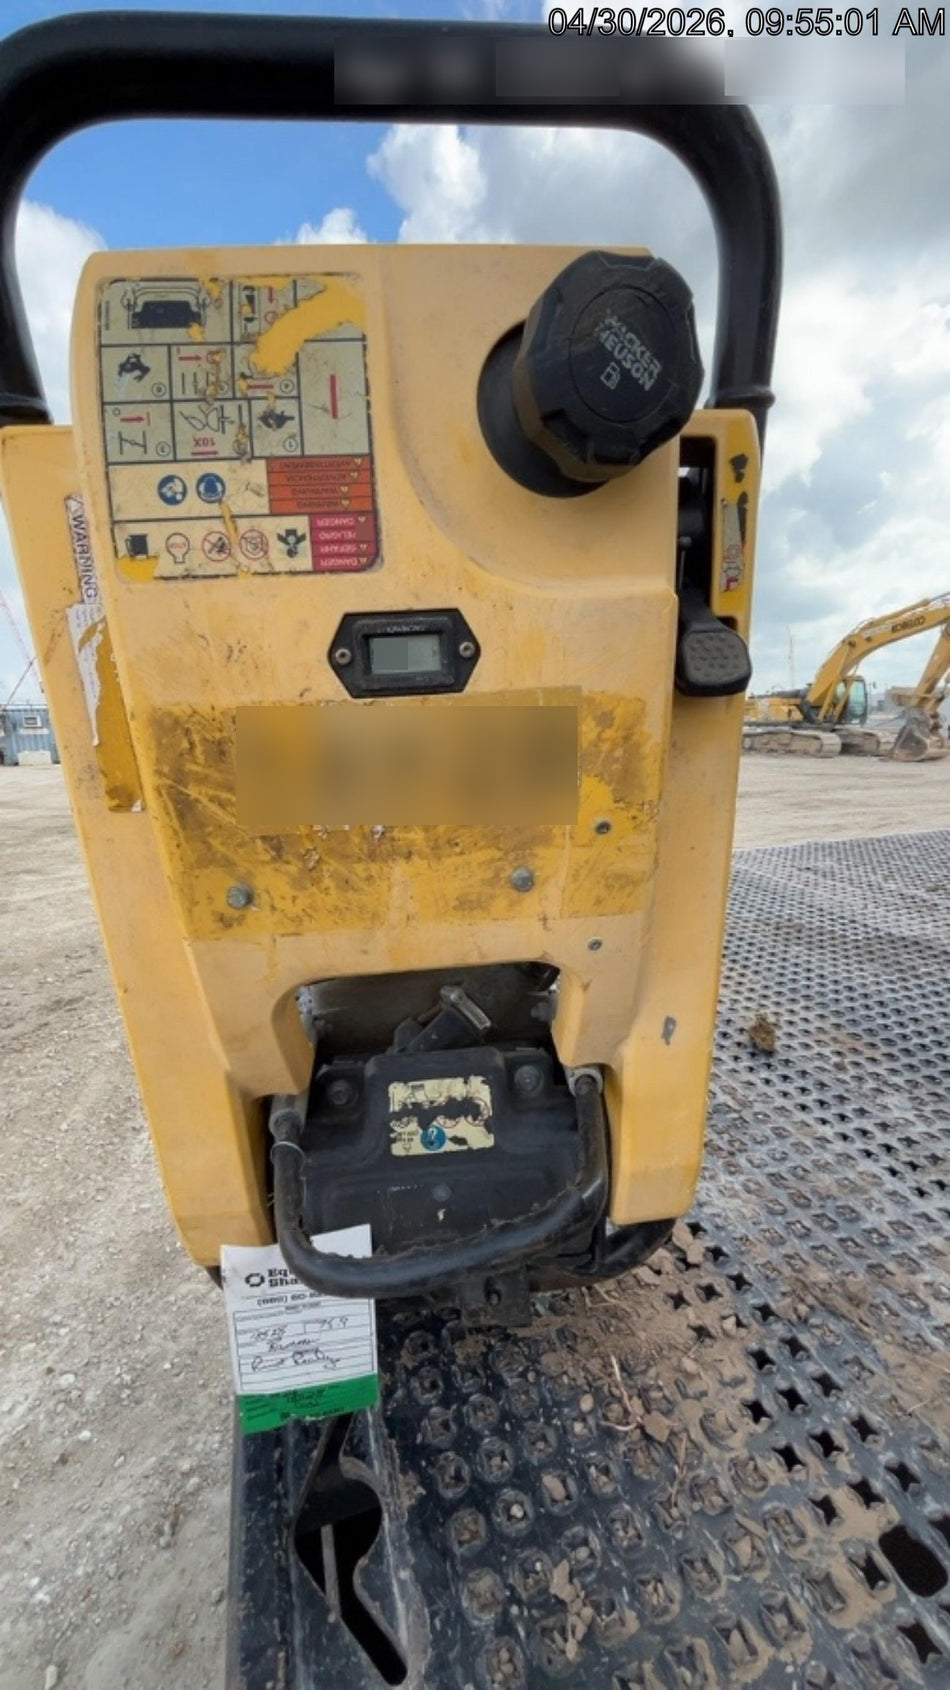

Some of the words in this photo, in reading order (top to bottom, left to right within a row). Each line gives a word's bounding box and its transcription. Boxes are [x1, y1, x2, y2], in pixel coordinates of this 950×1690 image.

[193, 437, 216, 448] 10X
[316, 517, 355, 526] DANGER
[72, 516, 98, 599] WARNING
[320, 557, 358, 566] DANGER
